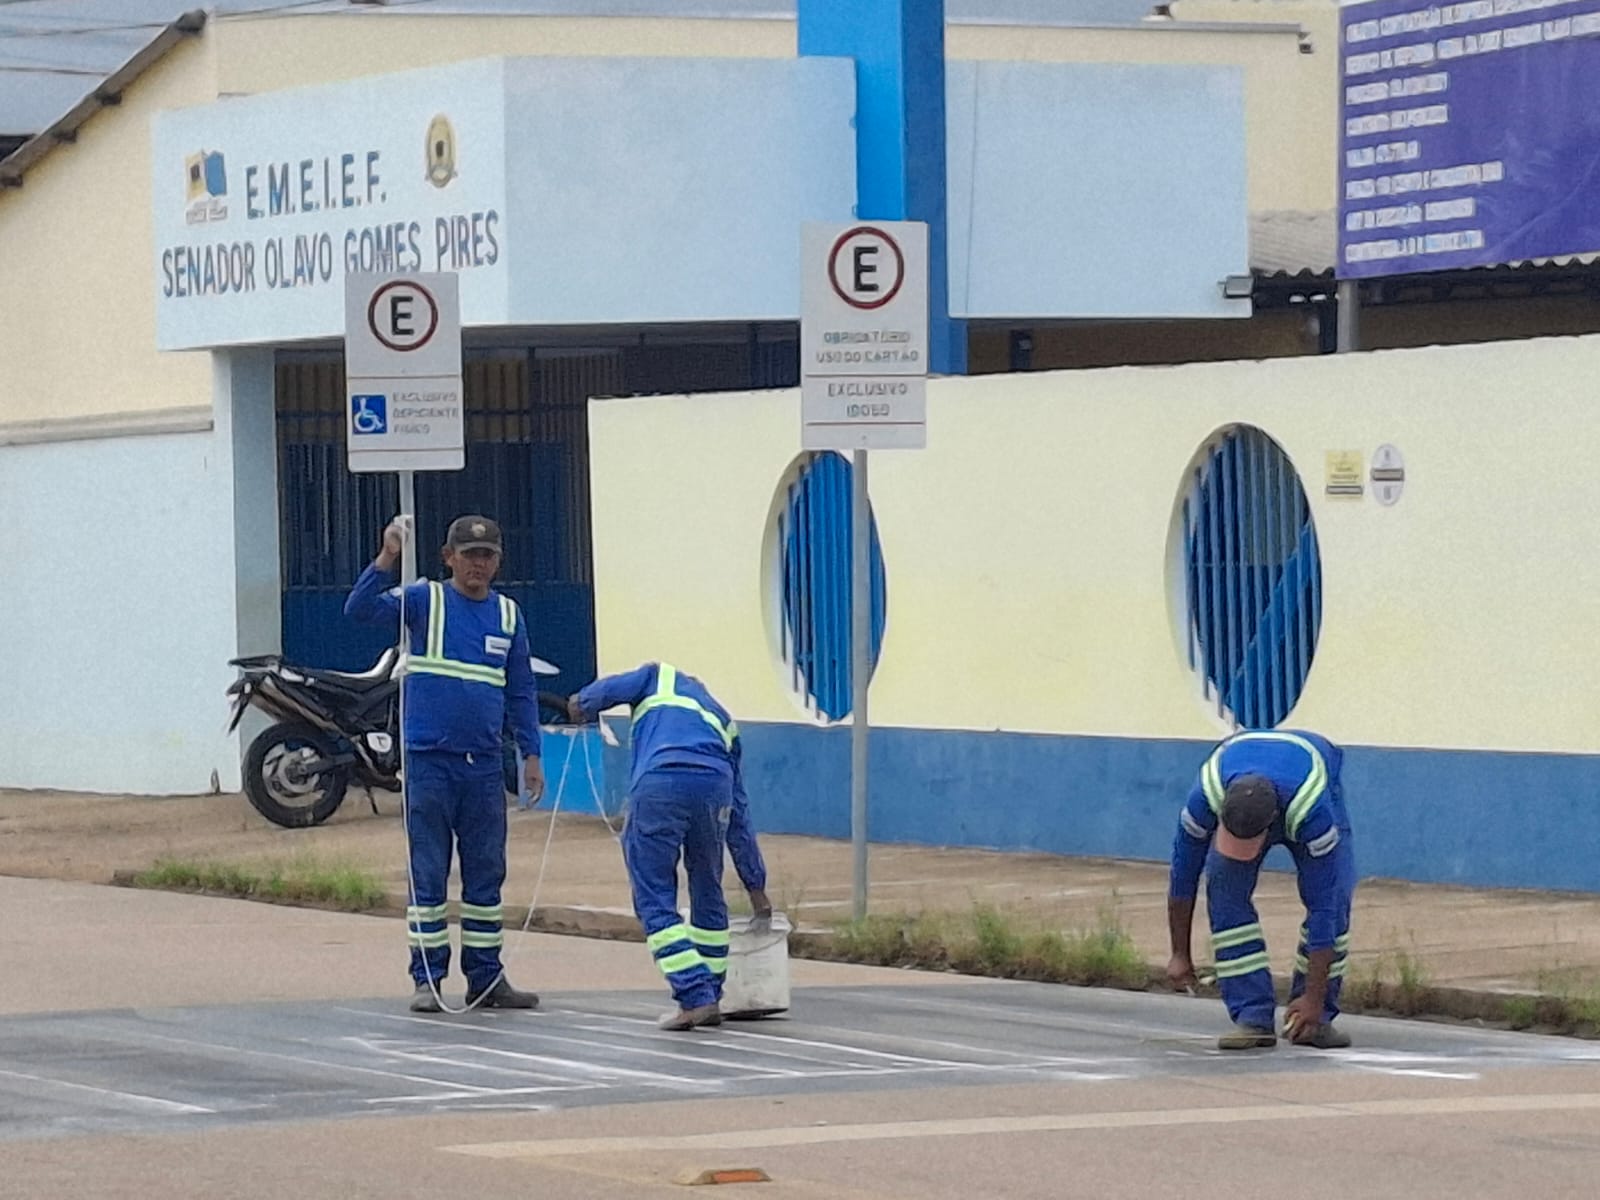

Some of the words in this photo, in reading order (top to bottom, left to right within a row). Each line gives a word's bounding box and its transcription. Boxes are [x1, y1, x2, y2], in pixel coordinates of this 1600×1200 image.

[162, 240, 257, 298] SENADOR
[264, 231, 334, 289] OLAVO
[344, 221, 422, 273] GOMES
[435, 209, 500, 272] PIRES
[854, 246, 880, 292] E
[390, 295, 415, 336] E
